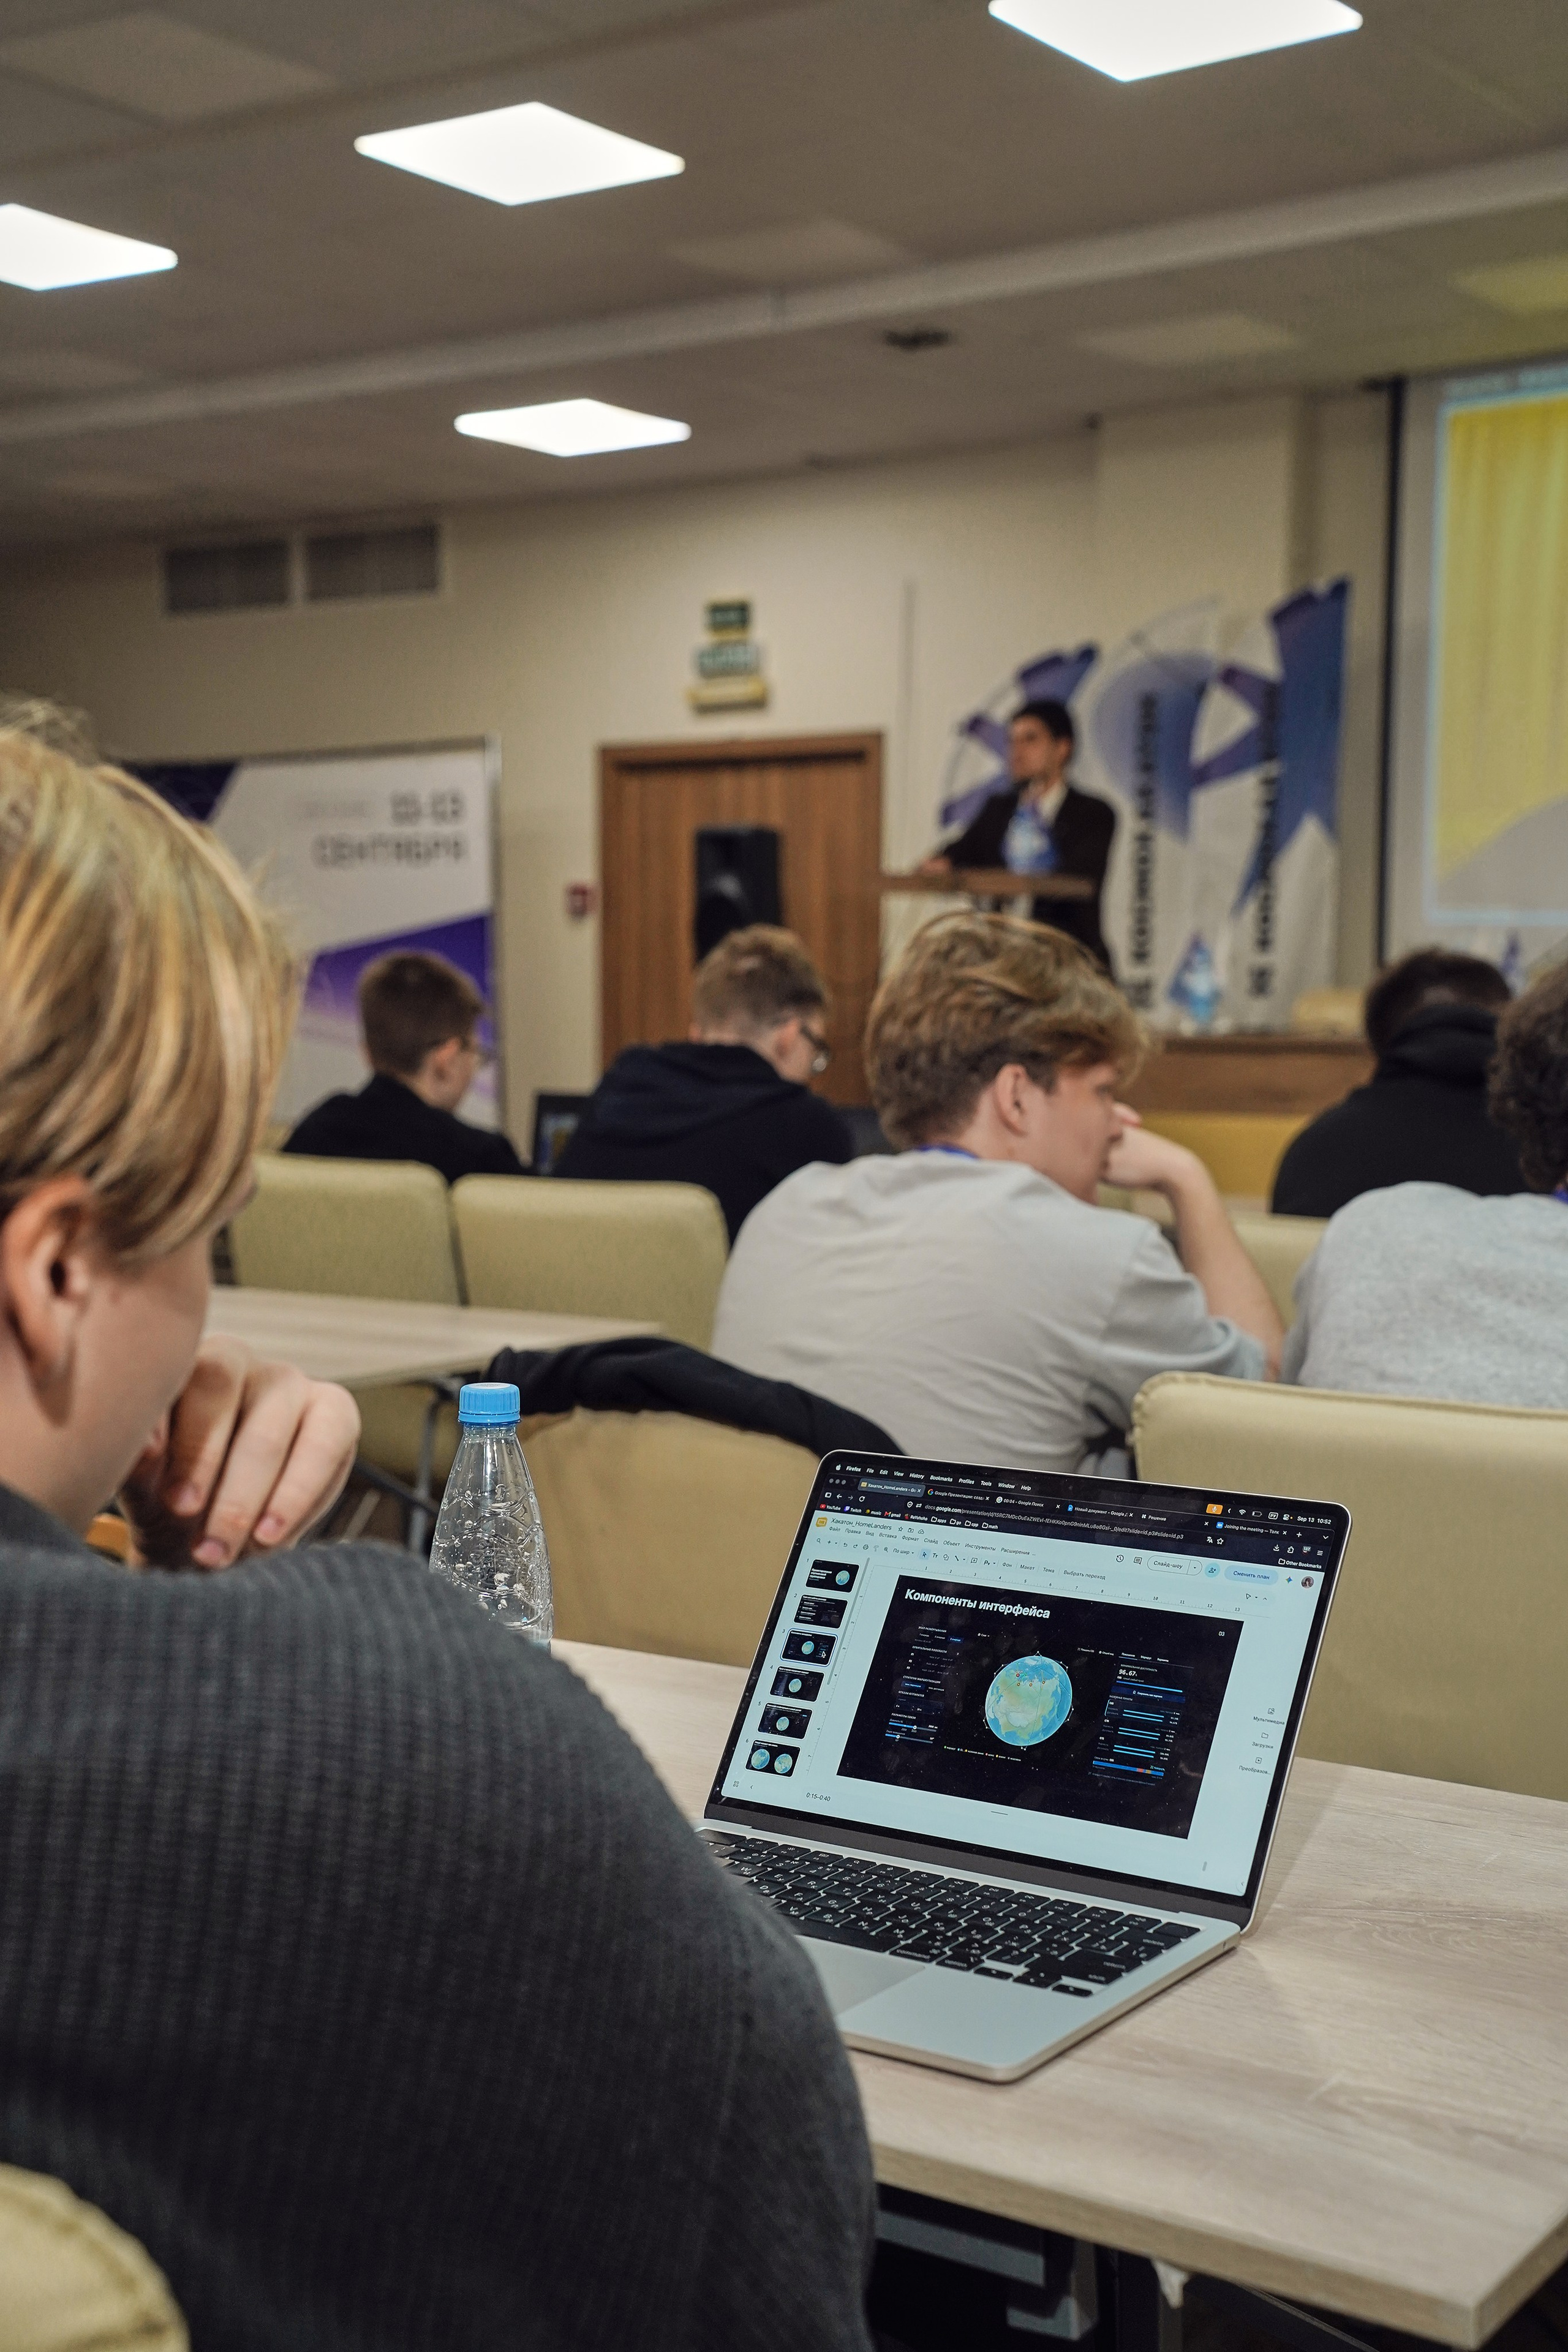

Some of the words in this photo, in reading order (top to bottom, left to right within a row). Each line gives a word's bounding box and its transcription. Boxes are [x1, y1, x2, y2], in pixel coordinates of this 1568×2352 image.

[831, 1518, 892, 1531] Хакатон_HomeLanders
[965, 1542, 997, 1551] Инструменты
[1001, 1547, 1030, 1556] Расширения
[1153, 1560, 1183, 1570] Слайд-шоу
[905, 1588, 978, 1609] Компоненты
[978, 1600, 1051, 1619] интерфейса
[1253, 1716, 1285, 1725] Мультимедиа
